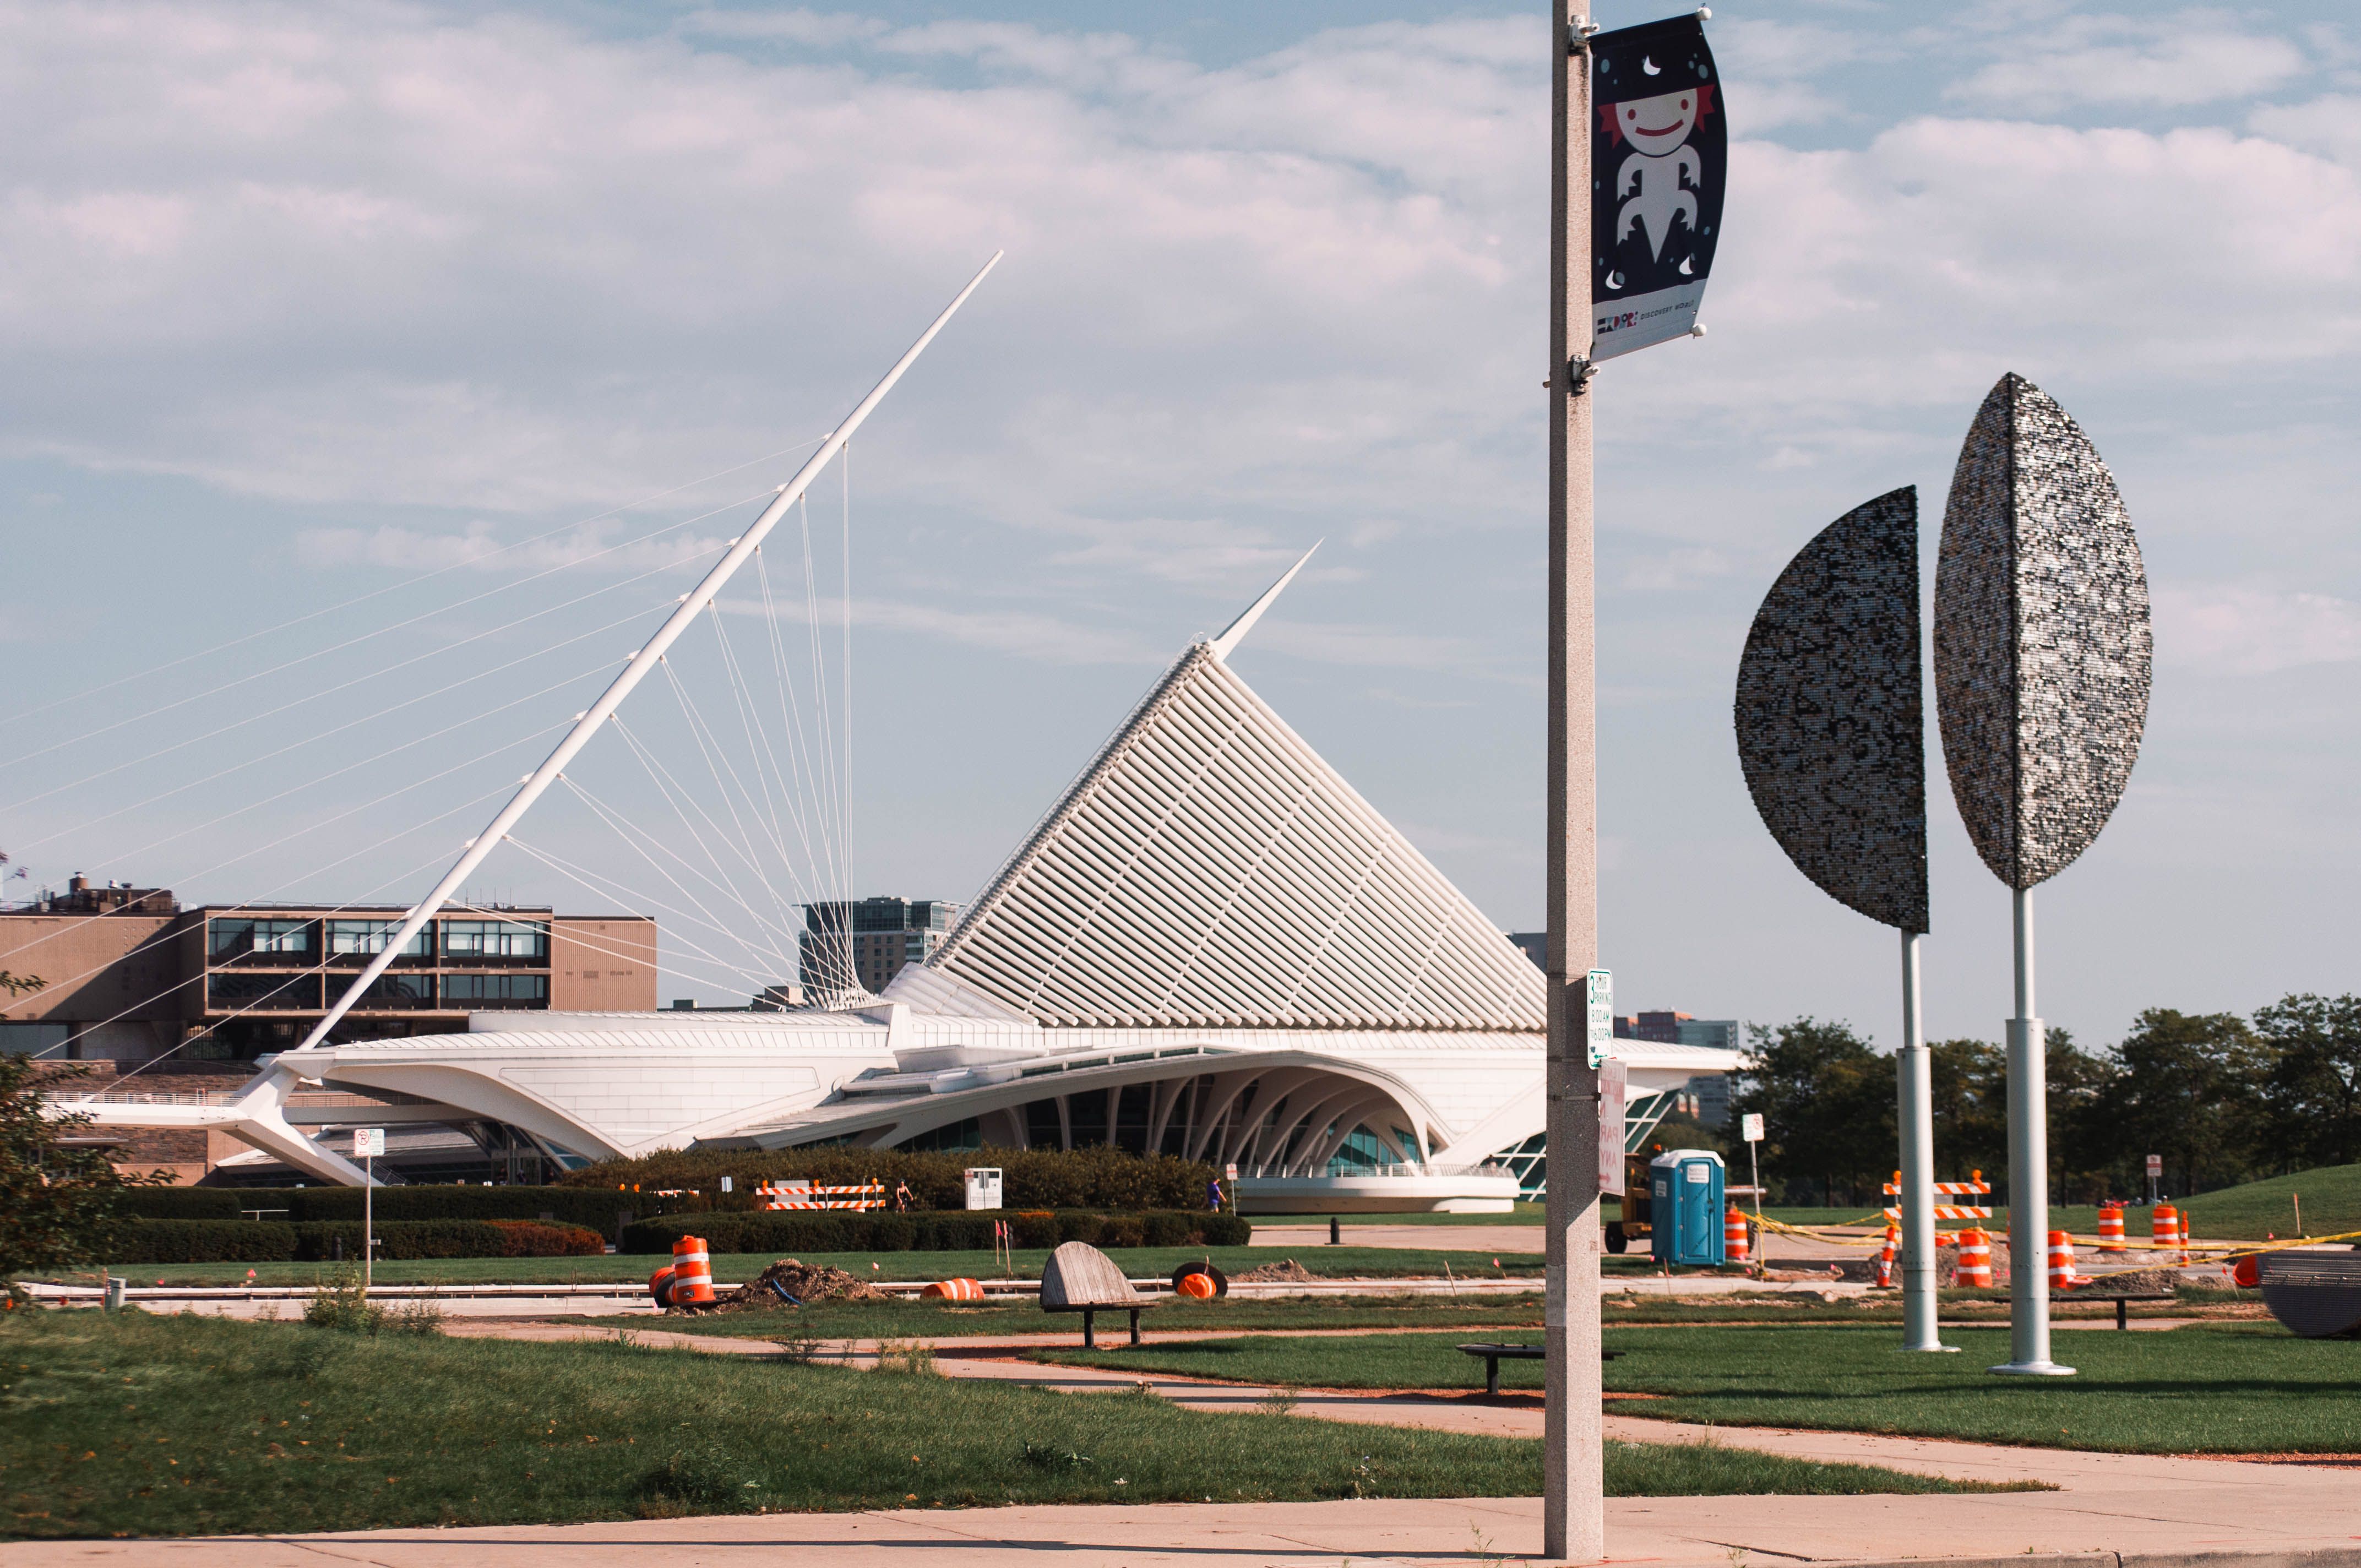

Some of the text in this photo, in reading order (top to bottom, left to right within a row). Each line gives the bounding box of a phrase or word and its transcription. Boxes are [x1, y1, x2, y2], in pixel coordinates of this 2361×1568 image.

[1640, 306, 1673, 319] DISCOVERY
[1590, 975, 1595, 1004] 3
[1597, 977, 1607, 989] HOUR
[1595, 992, 1612, 1005] PARKING
[1603, 1010, 1609, 1022] AM
